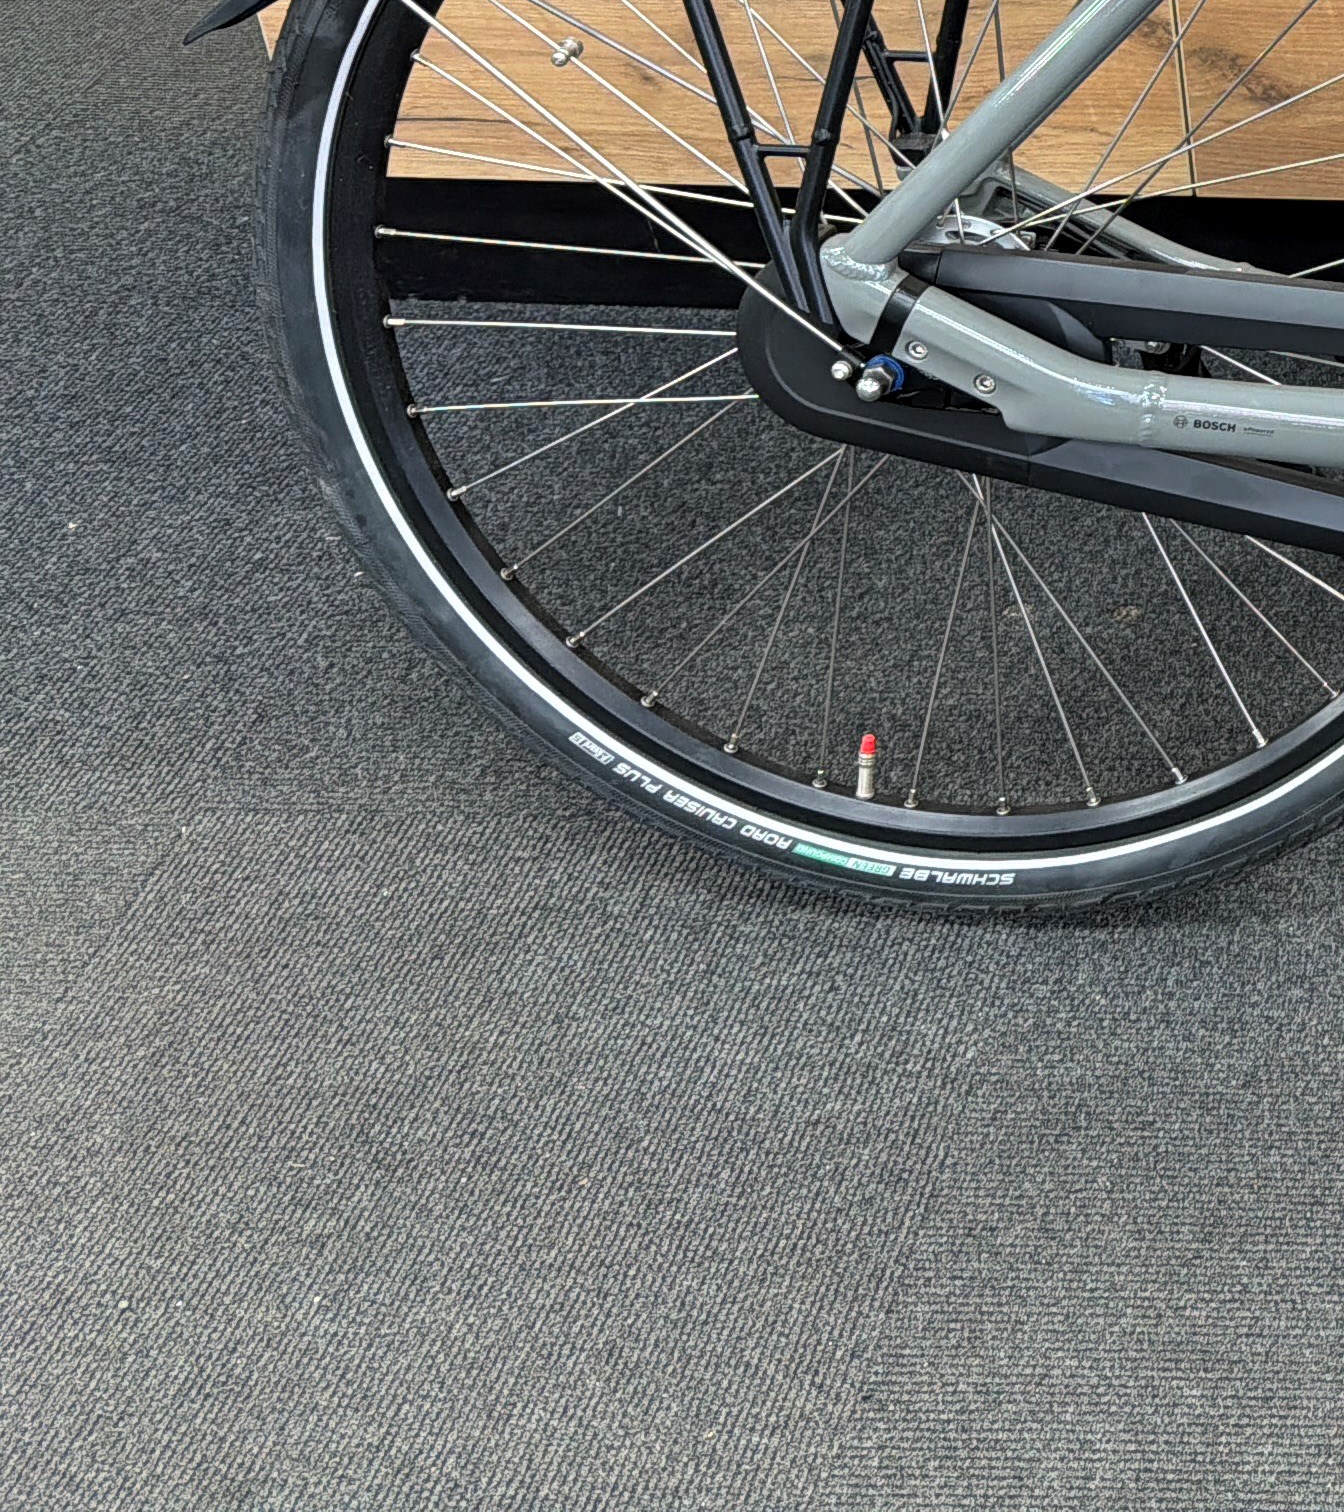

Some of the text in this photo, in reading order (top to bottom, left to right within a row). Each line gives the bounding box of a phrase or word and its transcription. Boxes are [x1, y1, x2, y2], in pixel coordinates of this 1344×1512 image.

[1193, 419, 1237, 433] BOSCH
[612, 762, 663, 794] PLUS
[662, 789, 738, 830] CRUISER
[739, 824, 793, 850] ROAD
[852, 859, 893, 876] GREEN
[899, 867, 1017, 886] SCHWALBE
